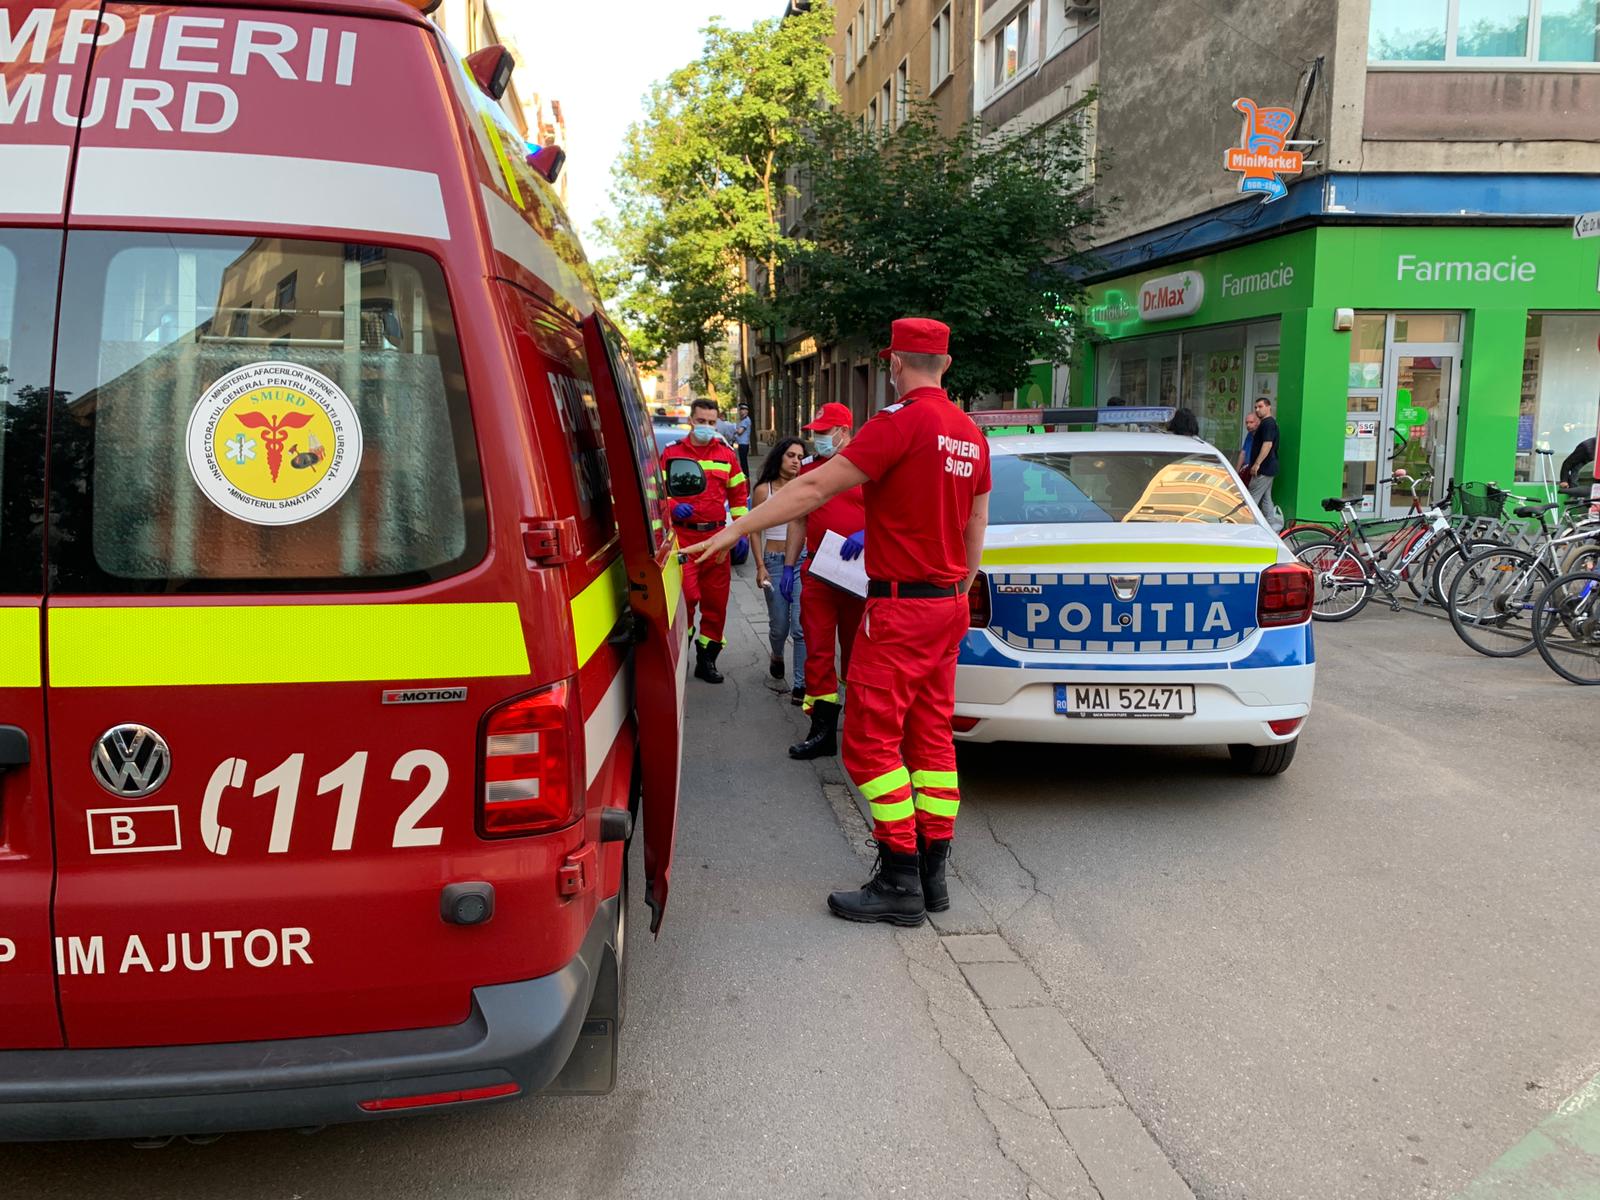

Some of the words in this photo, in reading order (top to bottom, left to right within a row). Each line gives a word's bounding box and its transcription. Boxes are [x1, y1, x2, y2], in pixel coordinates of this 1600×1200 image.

[1232, 153, 1297, 168] MiniMarket
[1222, 262, 1294, 298] Farmacie
[1397, 254, 1537, 282] Farmacie
[1143, 286, 1185, 312] Dr.Max
[211, 371, 252, 400] MINISTERUL
[253, 367, 304, 379] AFACERILOR
[304, 374, 335, 397] INTERNE
[251, 390, 306, 407] SMURD
[204, 405, 225, 480] INSPECTORATUL
[222, 379, 265, 405] GENERAL
[267, 377, 307, 391] PENTRU
[333, 419, 343, 432] DE
[229, 488, 277, 509] MINISTERUL
[1402, 530, 1434, 563] CUBE
[998, 585, 1040, 594] LOGAN
[1026, 601, 1232, 633] POLITIA
[1056, 700, 1067, 709] RO
[1075, 688, 1110, 709] MAI
[1119, 688, 1183, 710] 52471
[252, 748, 450, 854] 112
[110, 815, 136, 846] B
